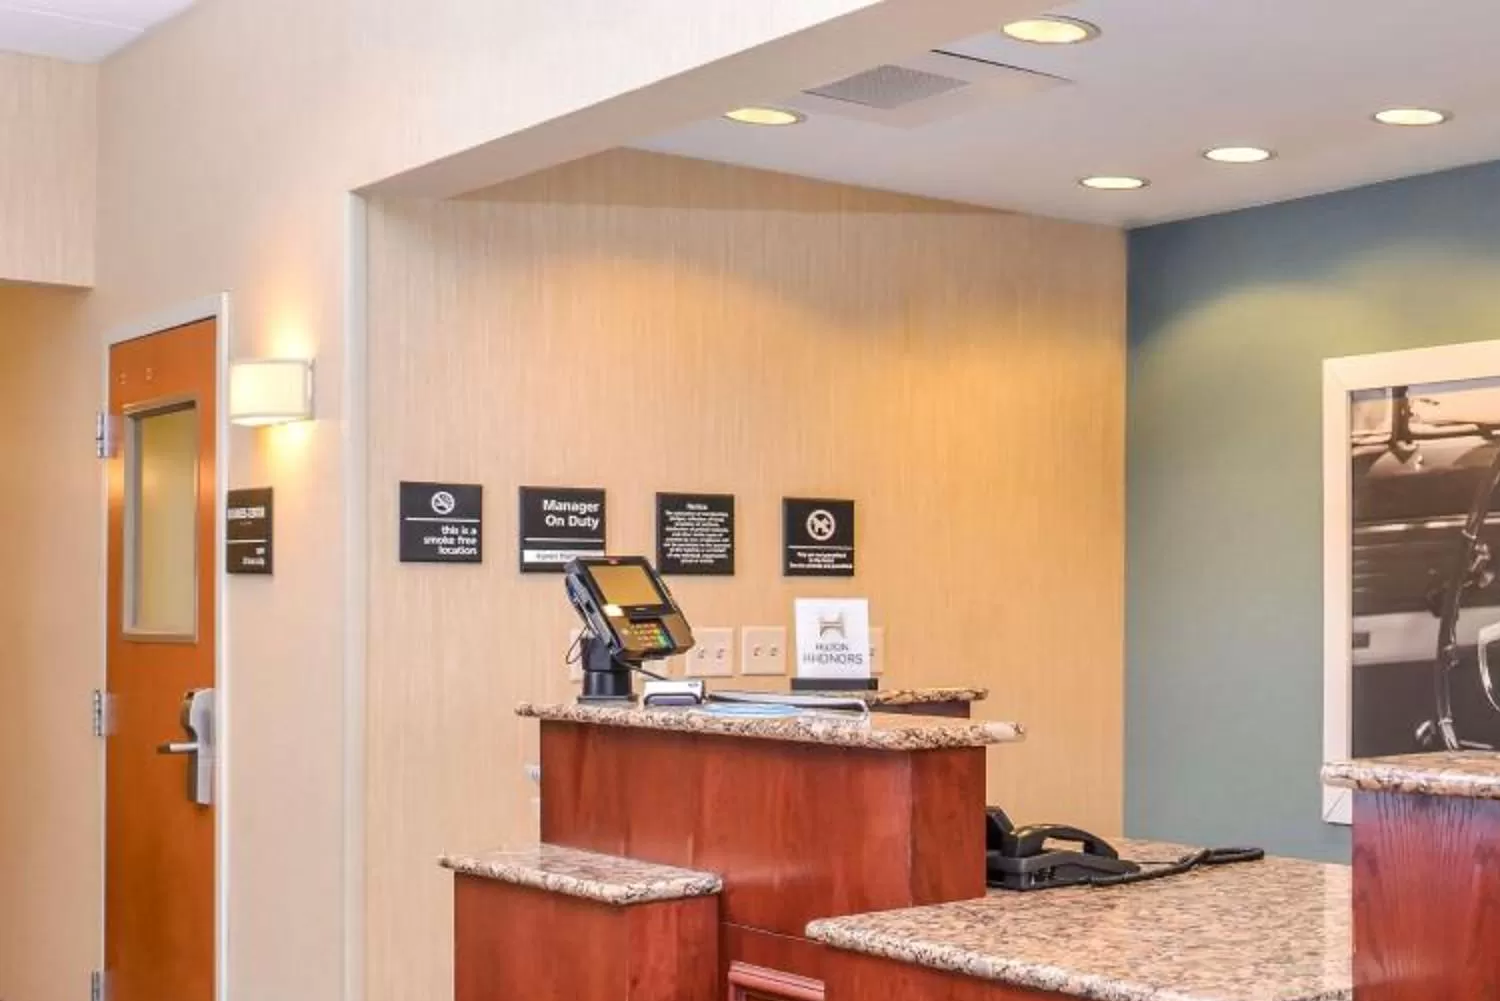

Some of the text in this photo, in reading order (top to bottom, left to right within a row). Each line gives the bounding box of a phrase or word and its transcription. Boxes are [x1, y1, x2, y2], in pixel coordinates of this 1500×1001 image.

[543, 498, 600, 515] Manager
[545, 514, 600, 531] On Duty
[441, 525, 459, 535] this
[461, 525, 469, 535] is
[423, 536, 477, 545] smoke free
[438, 546, 477, 555] location
